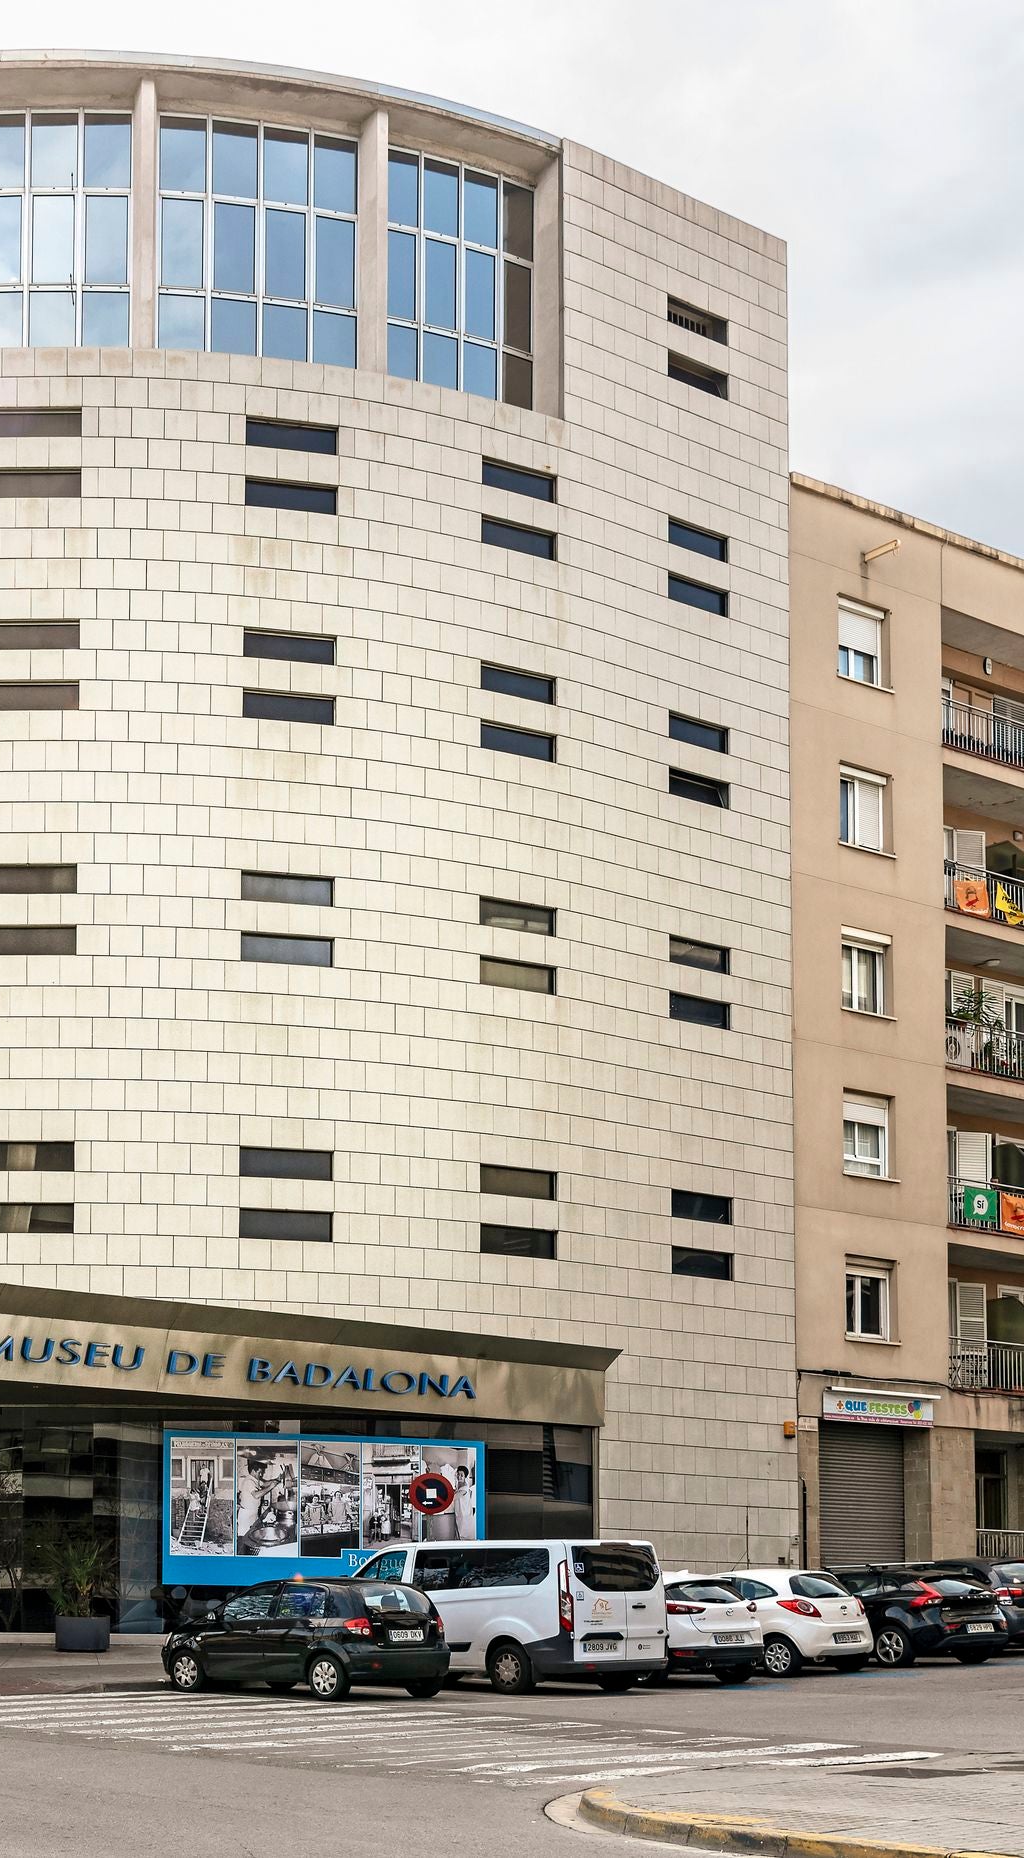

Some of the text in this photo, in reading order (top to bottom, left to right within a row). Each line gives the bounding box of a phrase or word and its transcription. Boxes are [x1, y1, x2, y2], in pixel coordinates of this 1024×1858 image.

[976, 1200, 985, 1210] Sí
[166, 1350, 227, 1379] DE
[247, 1356, 476, 1400] BADALONA
[845, 1400, 867, 1413] QUE
[869, 1402, 908, 1416] FESTES
[587, 1642, 604, 1652] 2809
